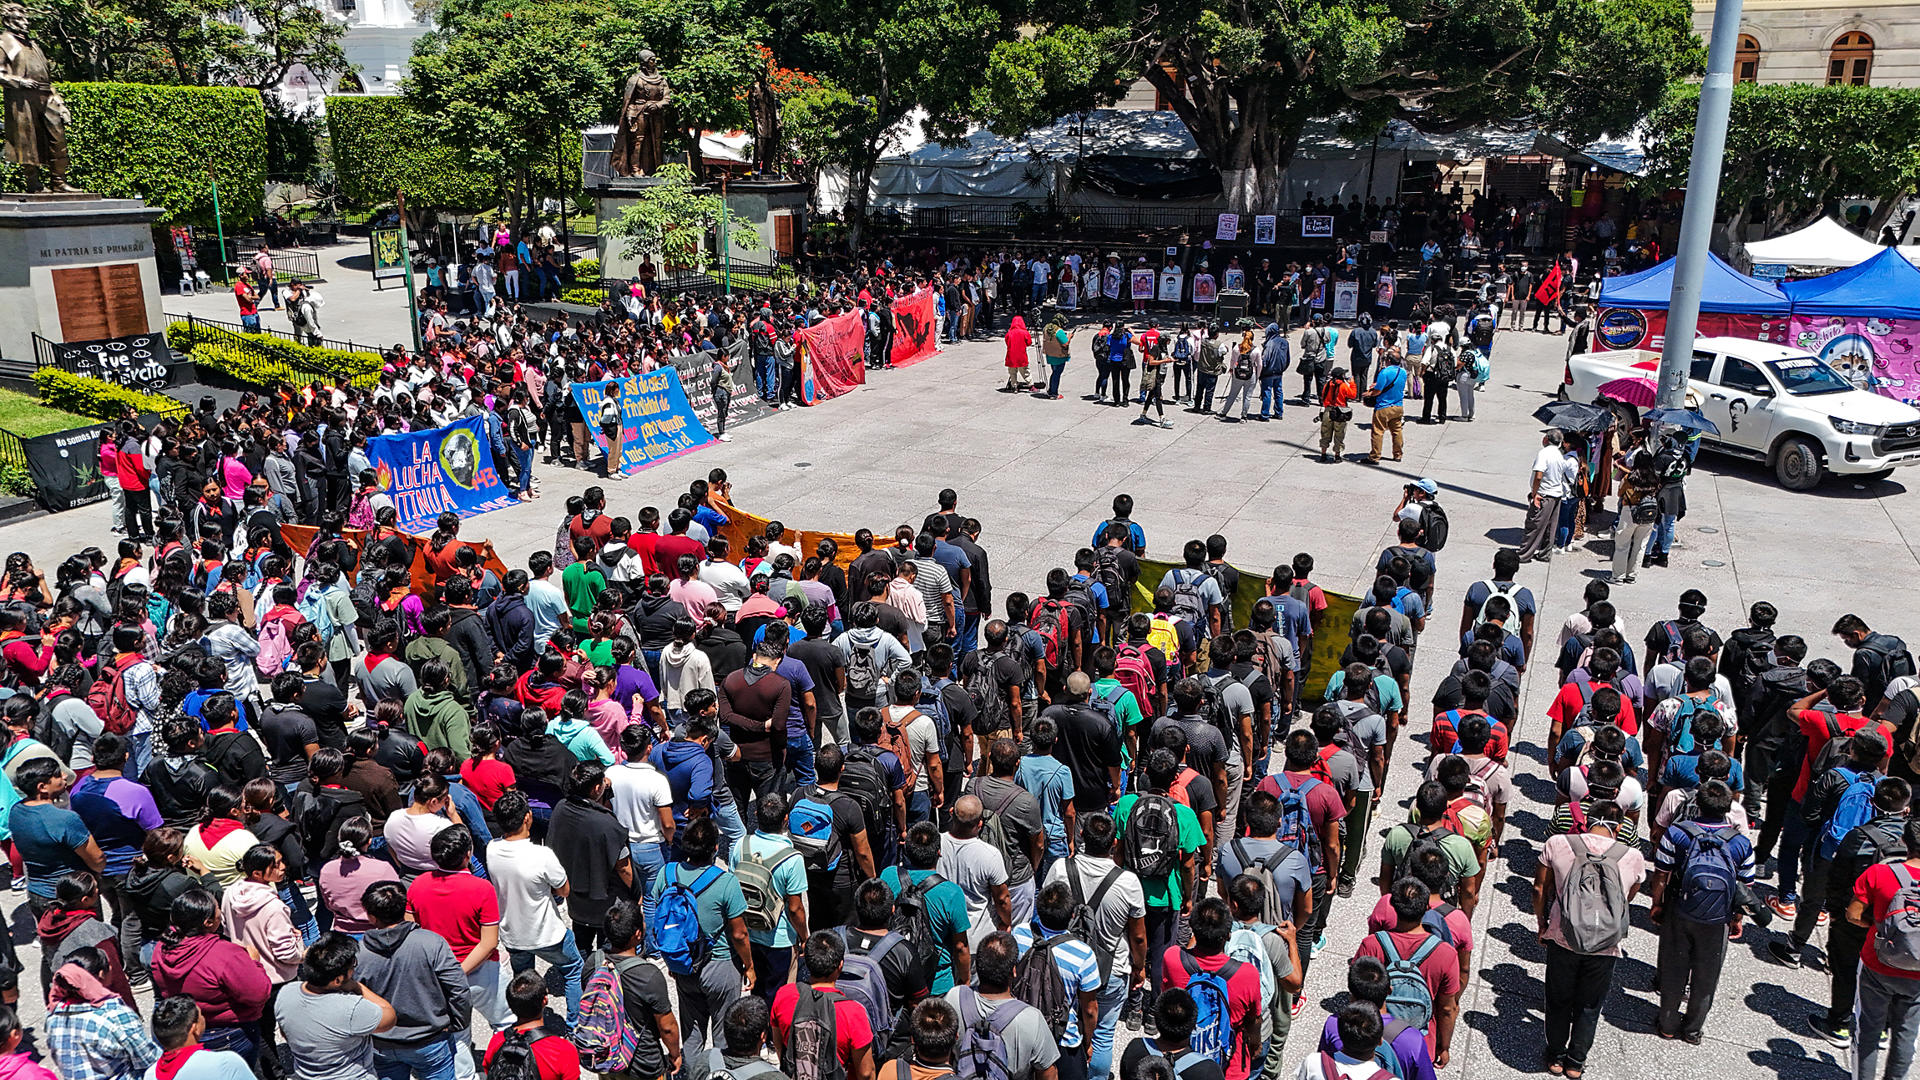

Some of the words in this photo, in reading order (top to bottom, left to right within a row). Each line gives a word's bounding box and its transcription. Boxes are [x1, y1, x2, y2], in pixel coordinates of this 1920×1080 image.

[40, 248, 51, 258] MI
[55, 247, 89, 256] PATRIA
[93, 246, 103, 255] ES
[107, 243, 144, 253] PRIMERO
[98, 352, 130, 368] Fue
[412, 440, 432, 465] LA
[393, 461, 443, 491] LUCHA
[388, 484, 458, 523] NTINUA
